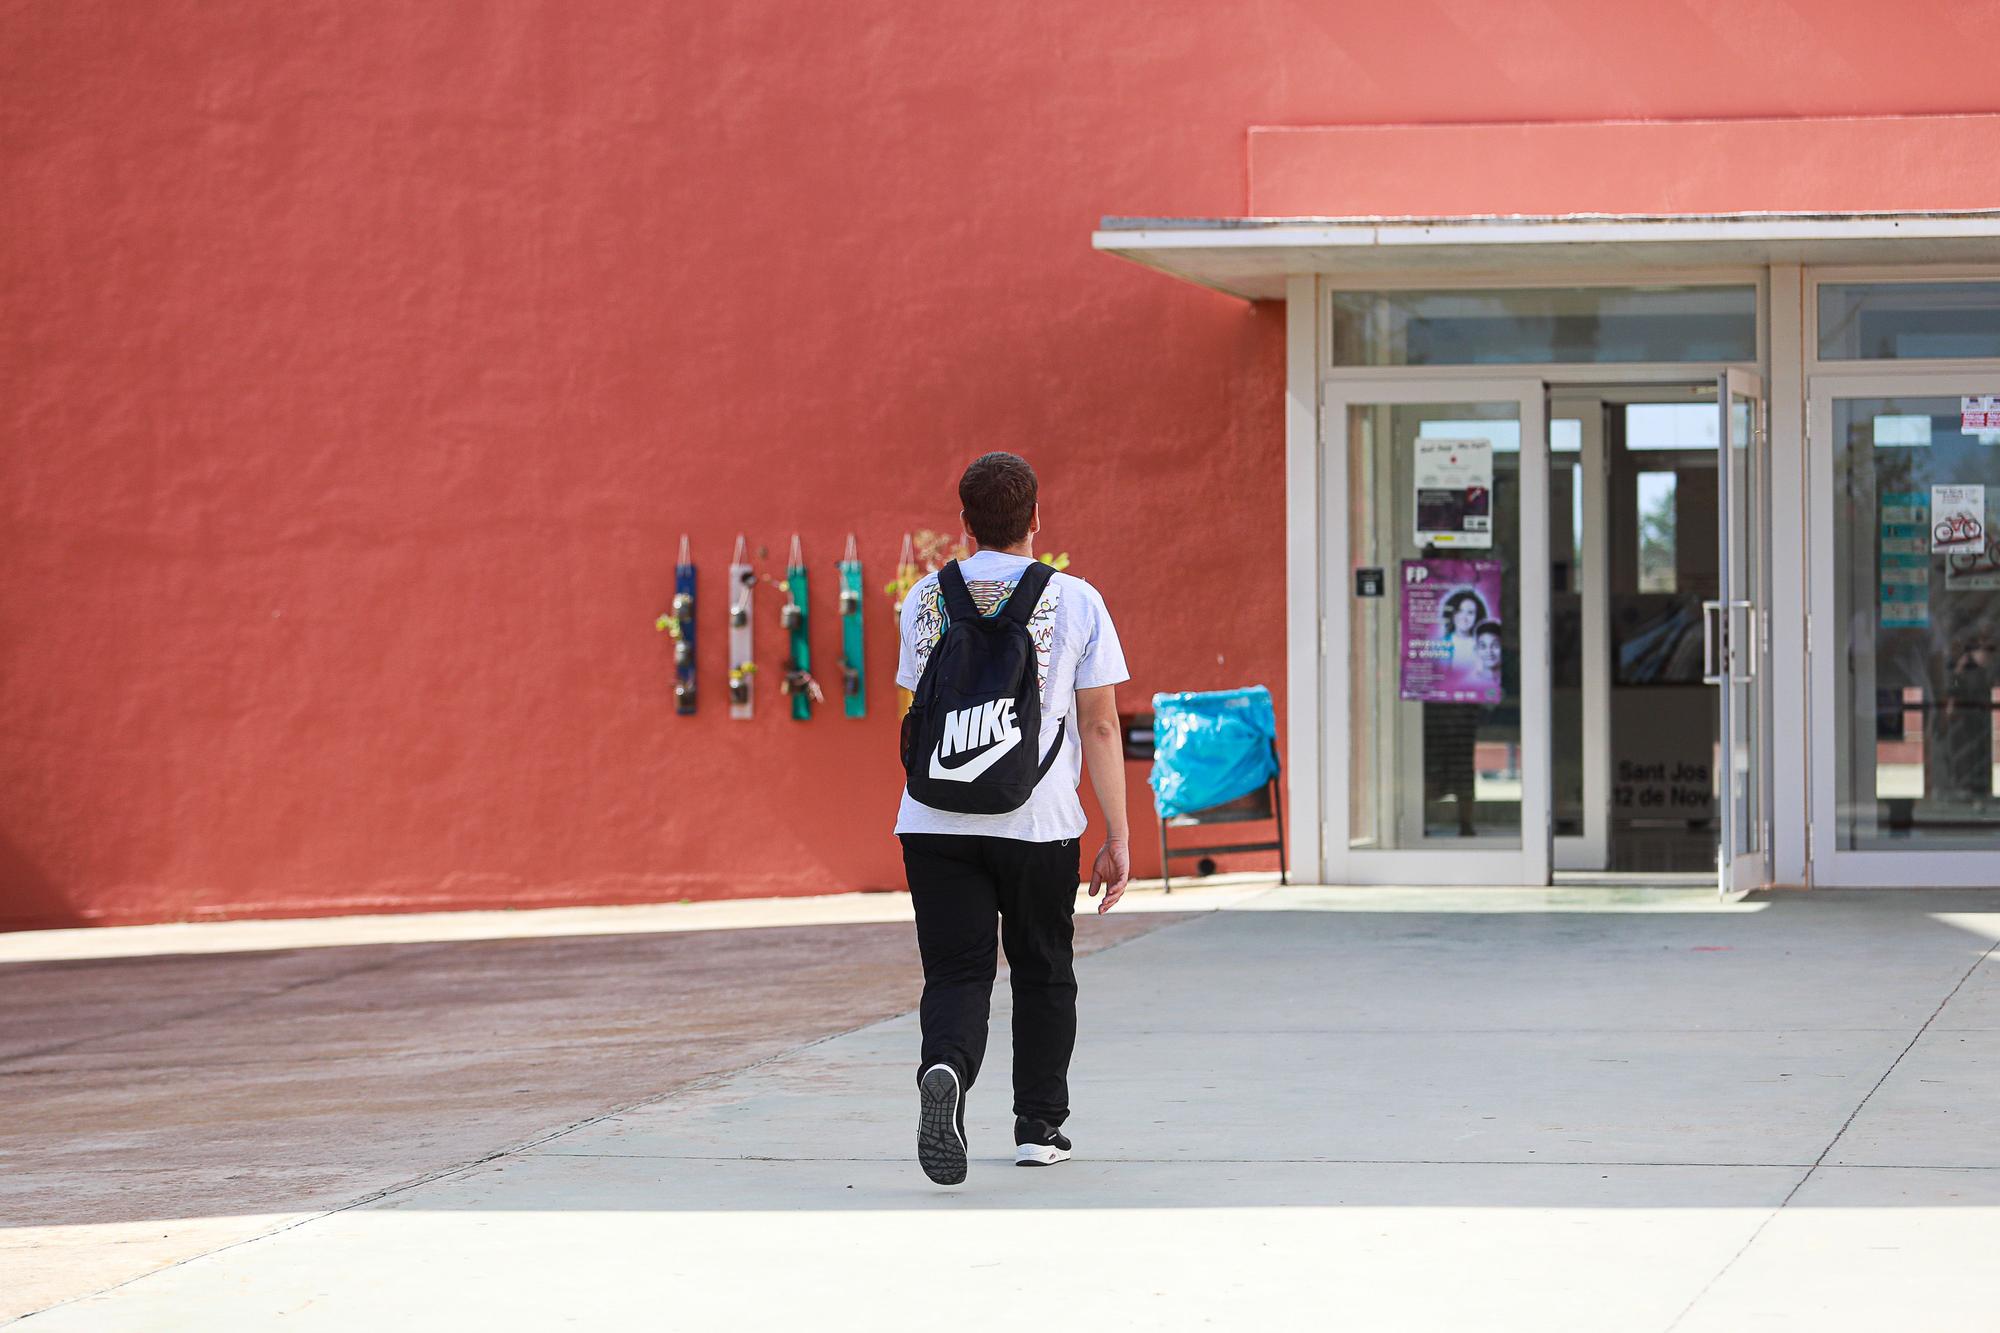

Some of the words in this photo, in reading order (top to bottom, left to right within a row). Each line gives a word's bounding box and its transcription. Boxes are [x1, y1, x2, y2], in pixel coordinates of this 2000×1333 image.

[1406, 566, 1428, 583] FP
[941, 698, 1020, 758] NIKE
[1618, 760, 1665, 782] Sant
[1639, 785, 1665, 807] de
